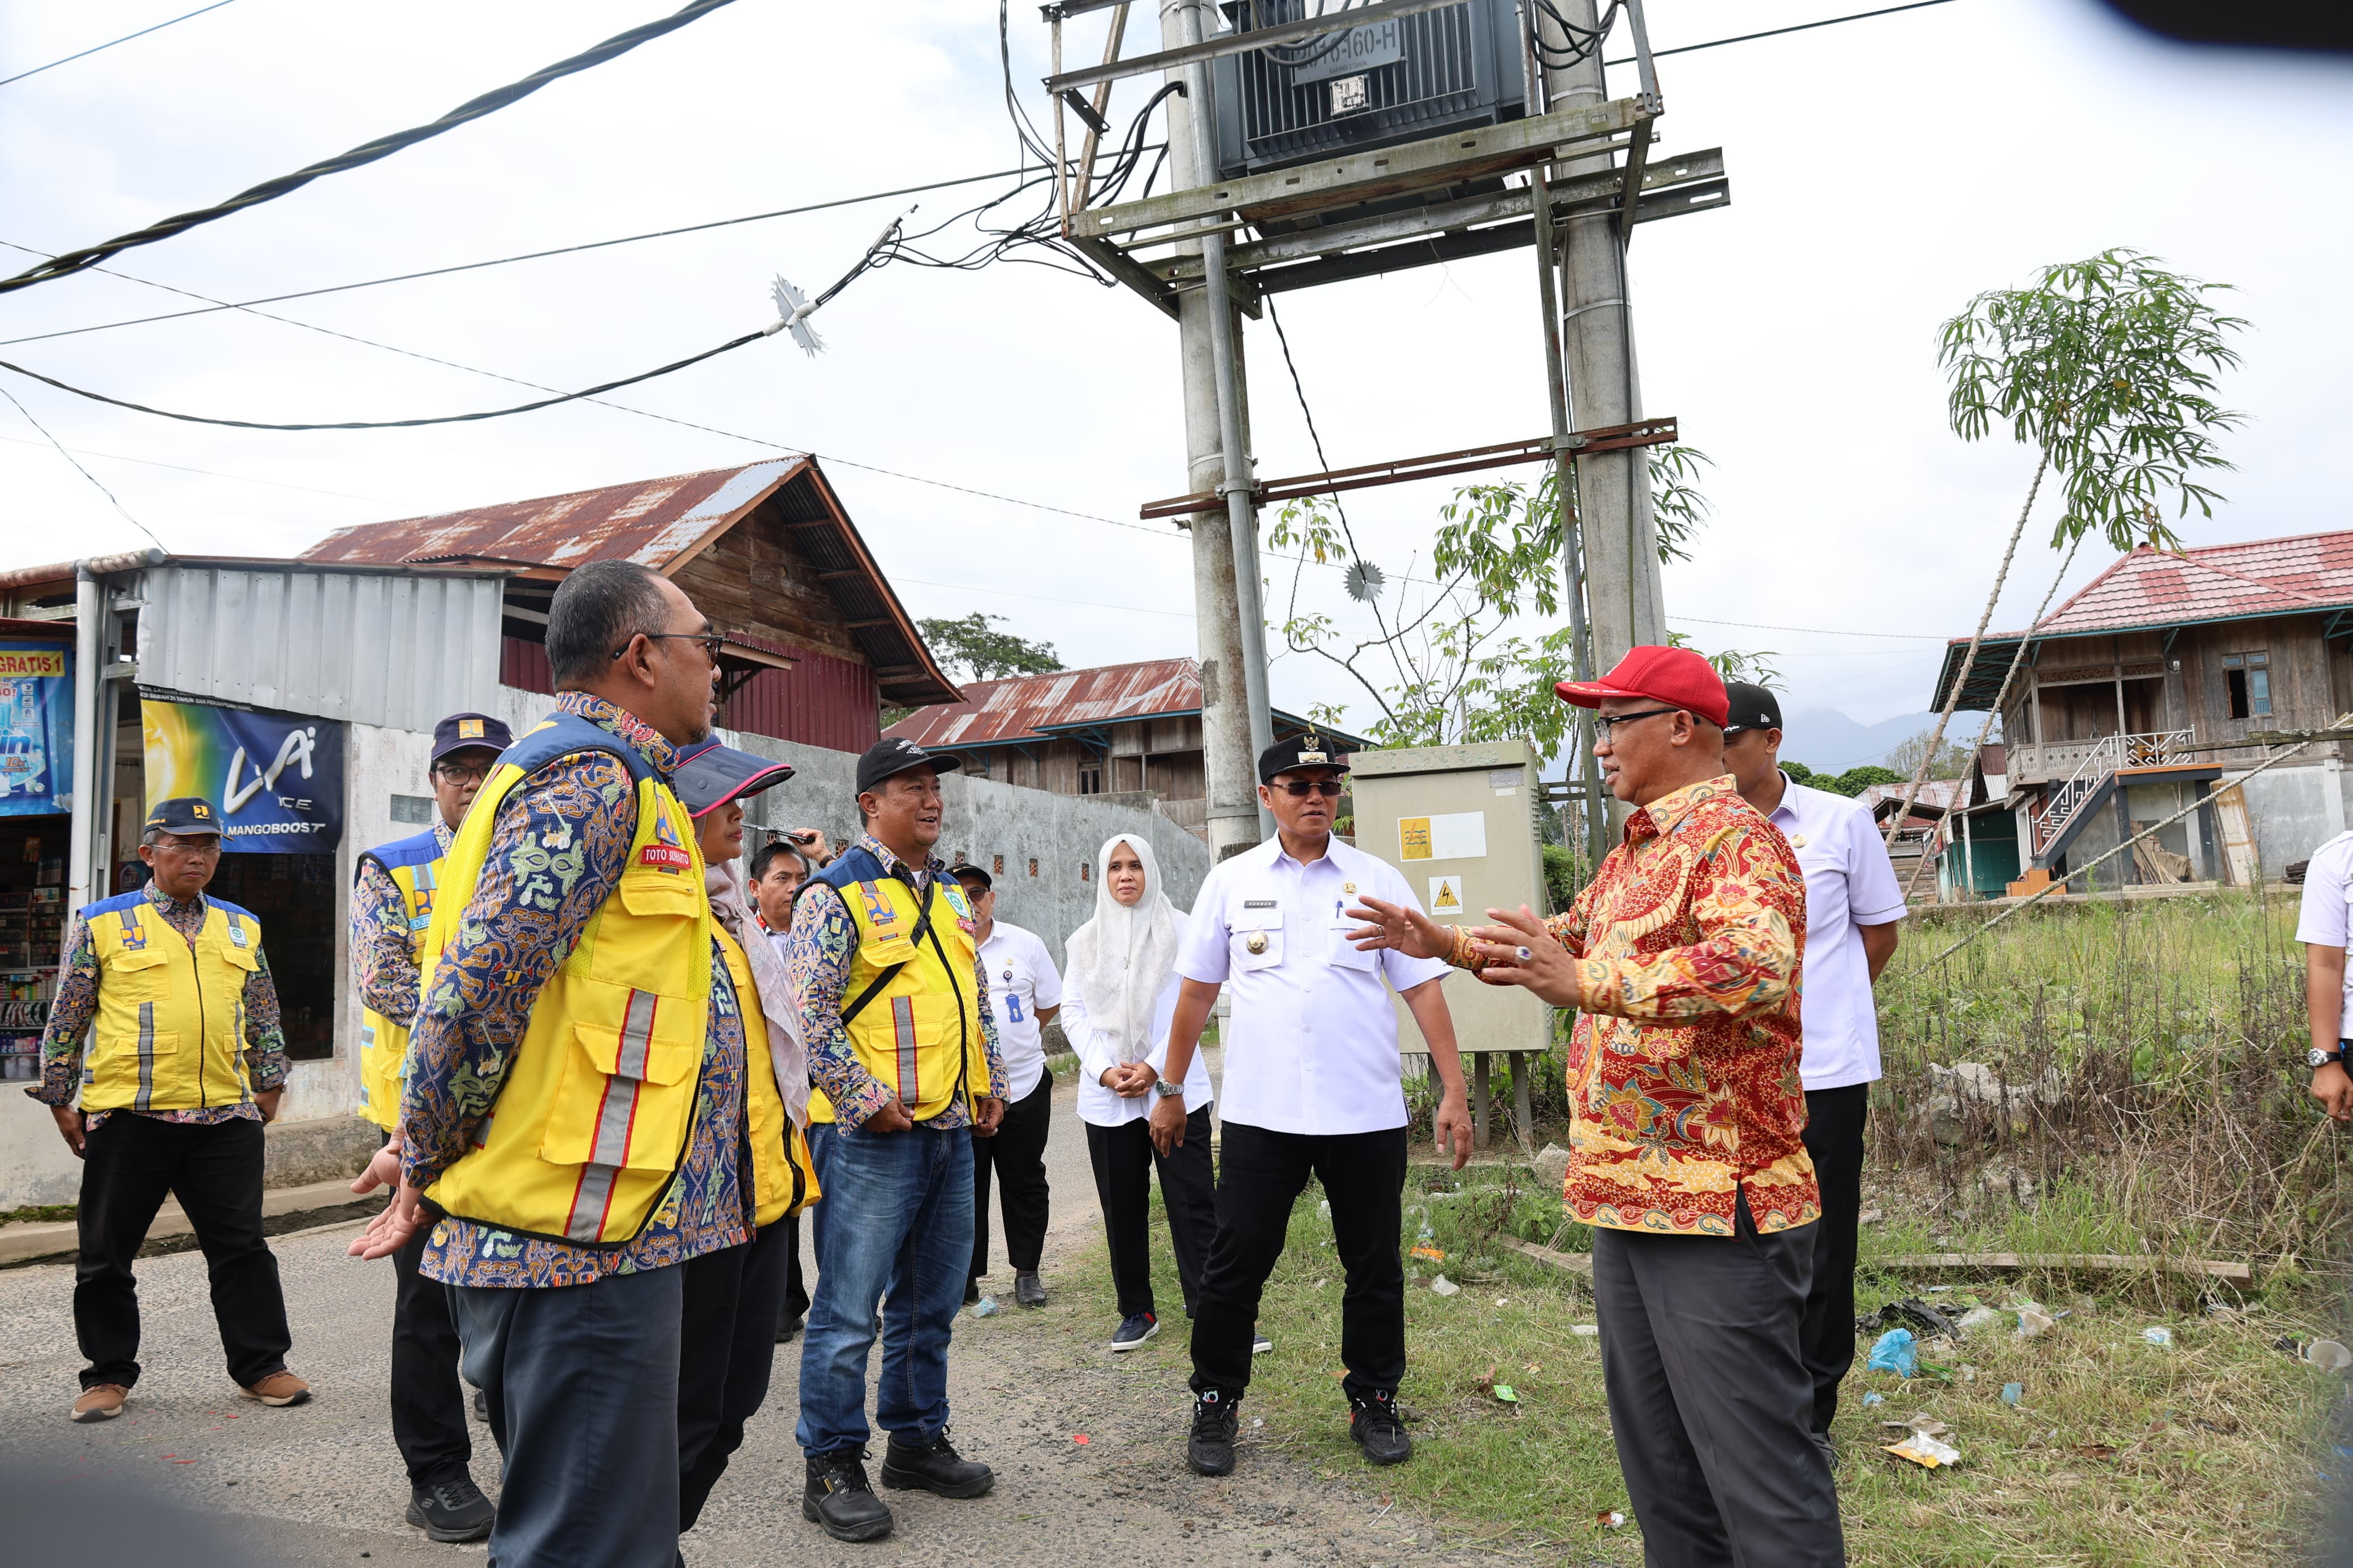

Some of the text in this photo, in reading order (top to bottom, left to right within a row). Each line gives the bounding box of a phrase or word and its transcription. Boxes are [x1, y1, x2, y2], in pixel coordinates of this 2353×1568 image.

[1329, 64, 1348, 74] GARANSI
[1352, 60, 1367, 68] TAHUN
[0, 656, 61, 672] GRATIS 1
[0, 729, 31, 754] in
[278, 796, 312, 810] ICE
[227, 822, 326, 836] MANGOBOOST
[645, 849, 689, 865] TOTO SUHARTO
